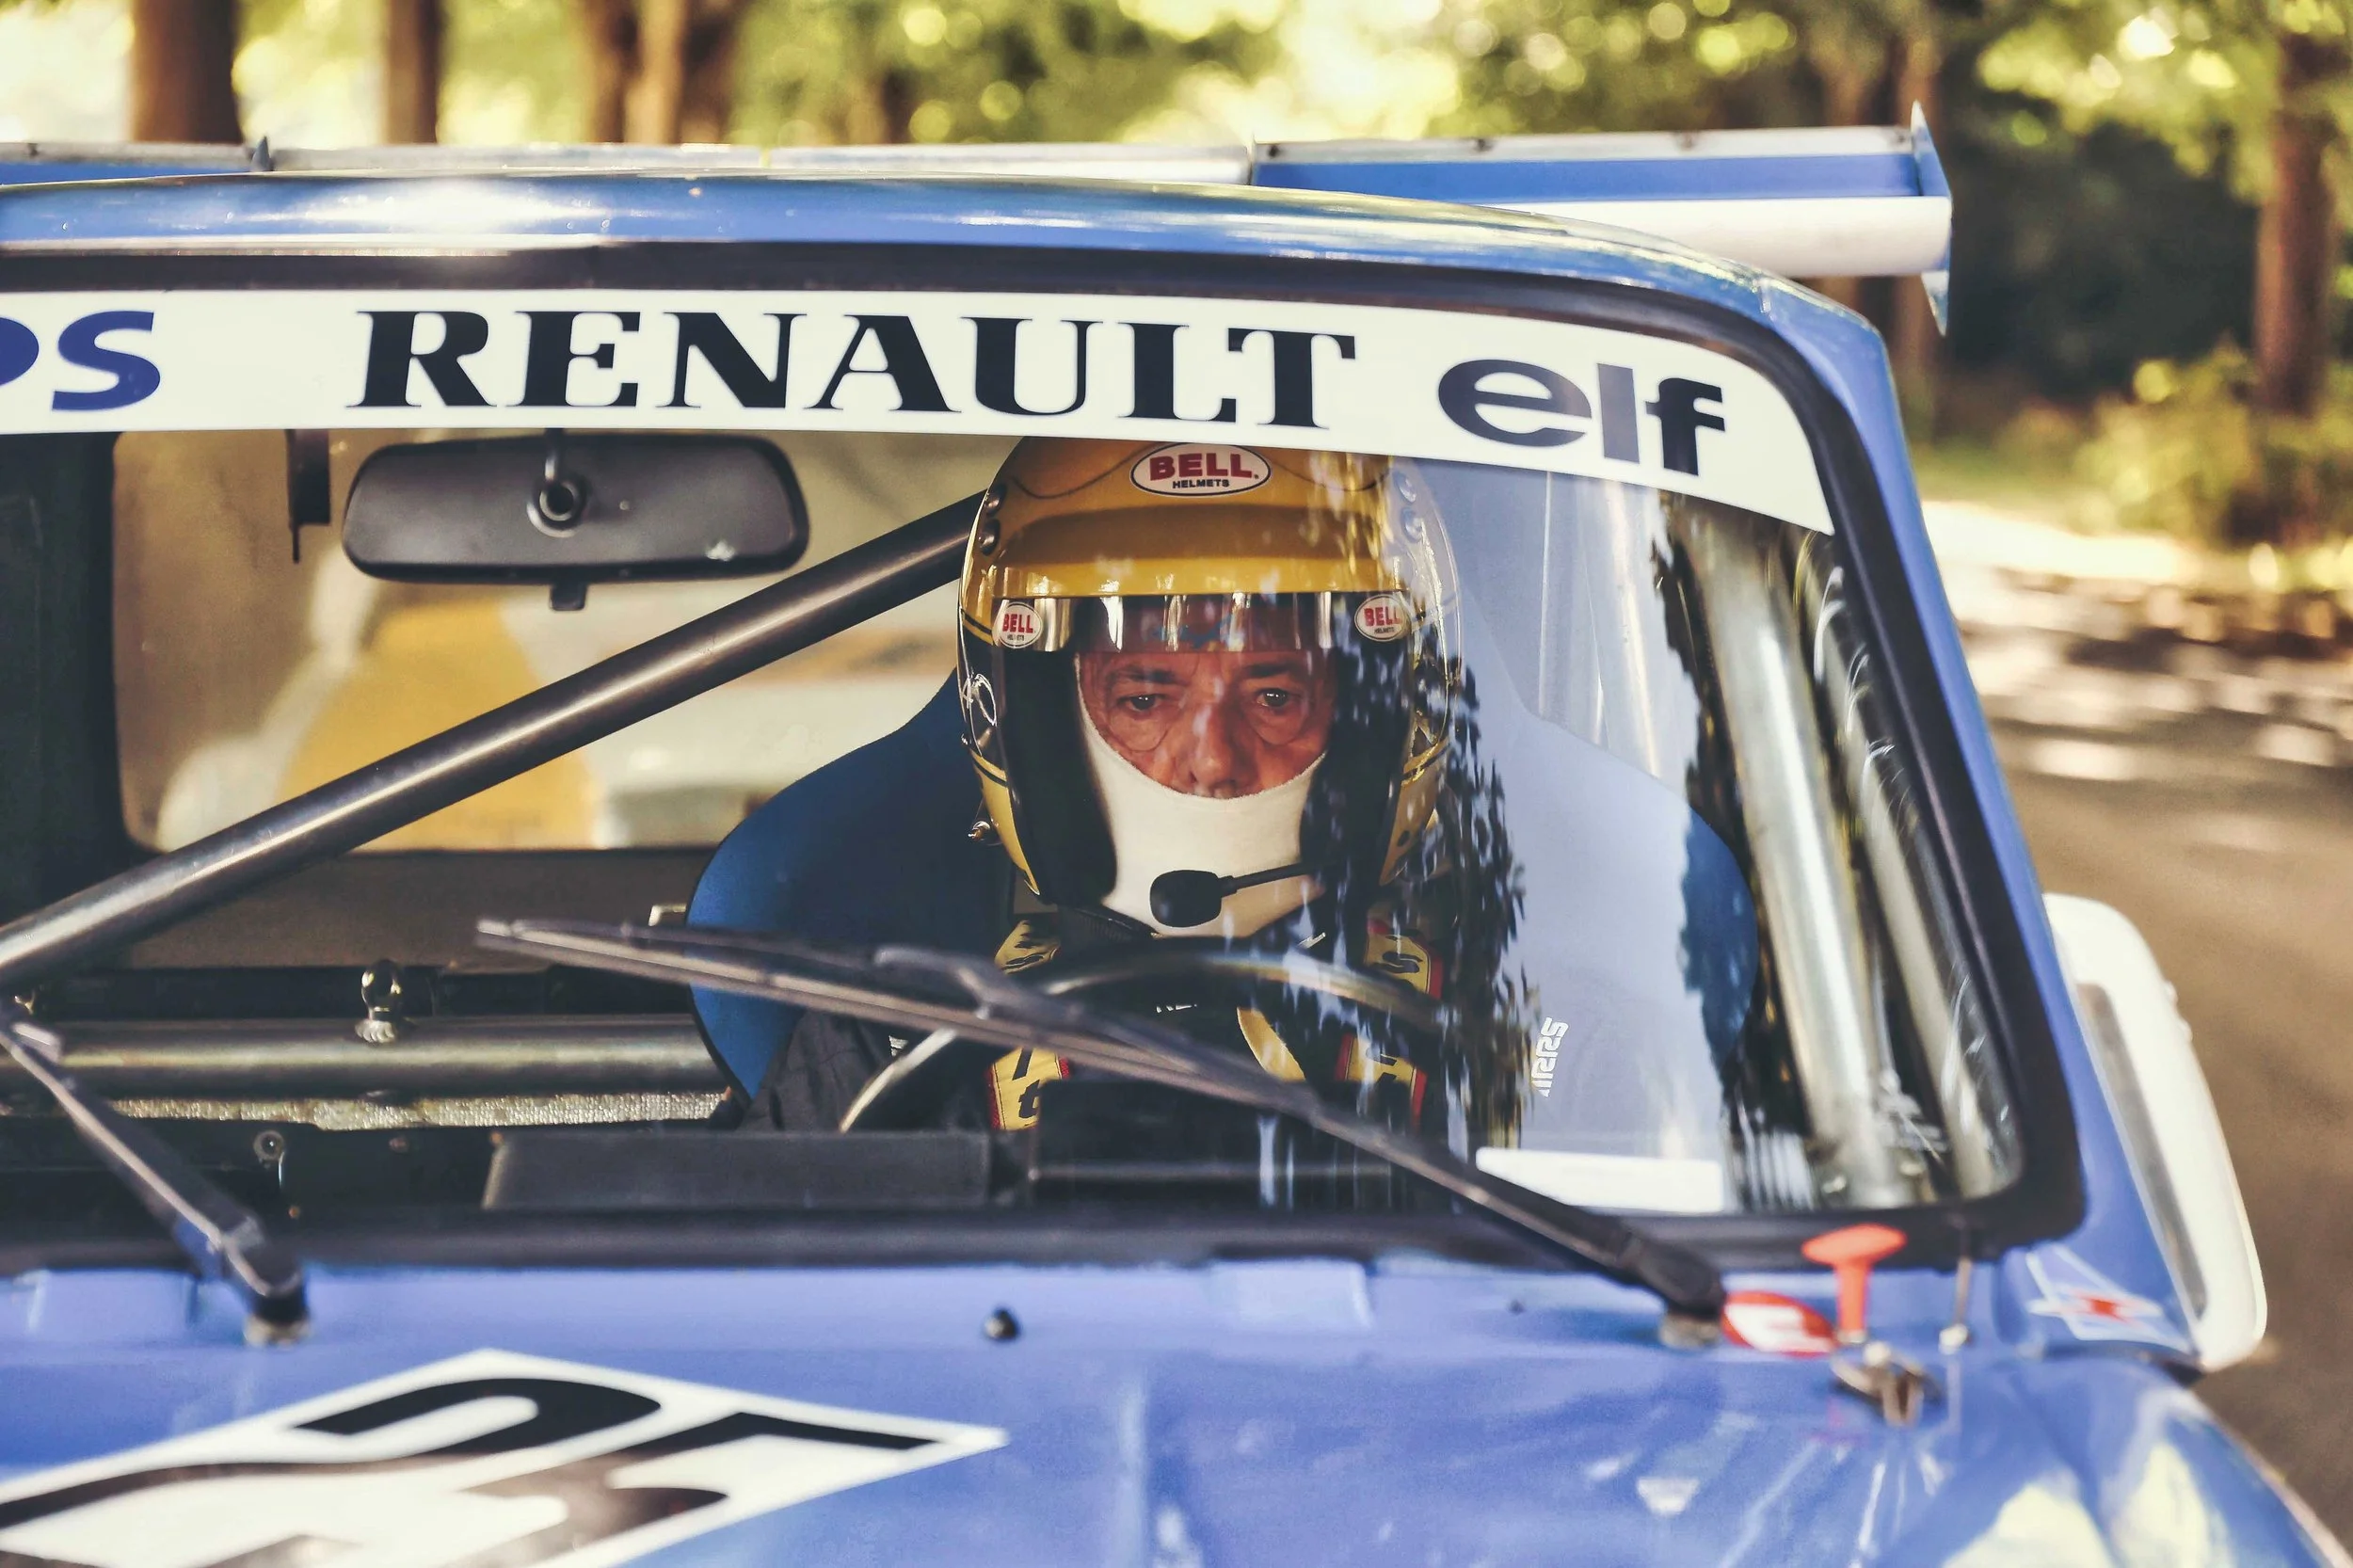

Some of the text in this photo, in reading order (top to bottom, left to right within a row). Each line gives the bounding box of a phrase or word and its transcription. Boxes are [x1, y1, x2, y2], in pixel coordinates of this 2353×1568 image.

[344, 310, 1356, 430] RENAULT
[1437, 358, 1726, 477] elf
[1149, 452, 1253, 482] BELL
[1172, 478, 1230, 489] HELMETS
[1001, 613, 1034, 634] BELL
[1363, 605, 1403, 627] BELL
